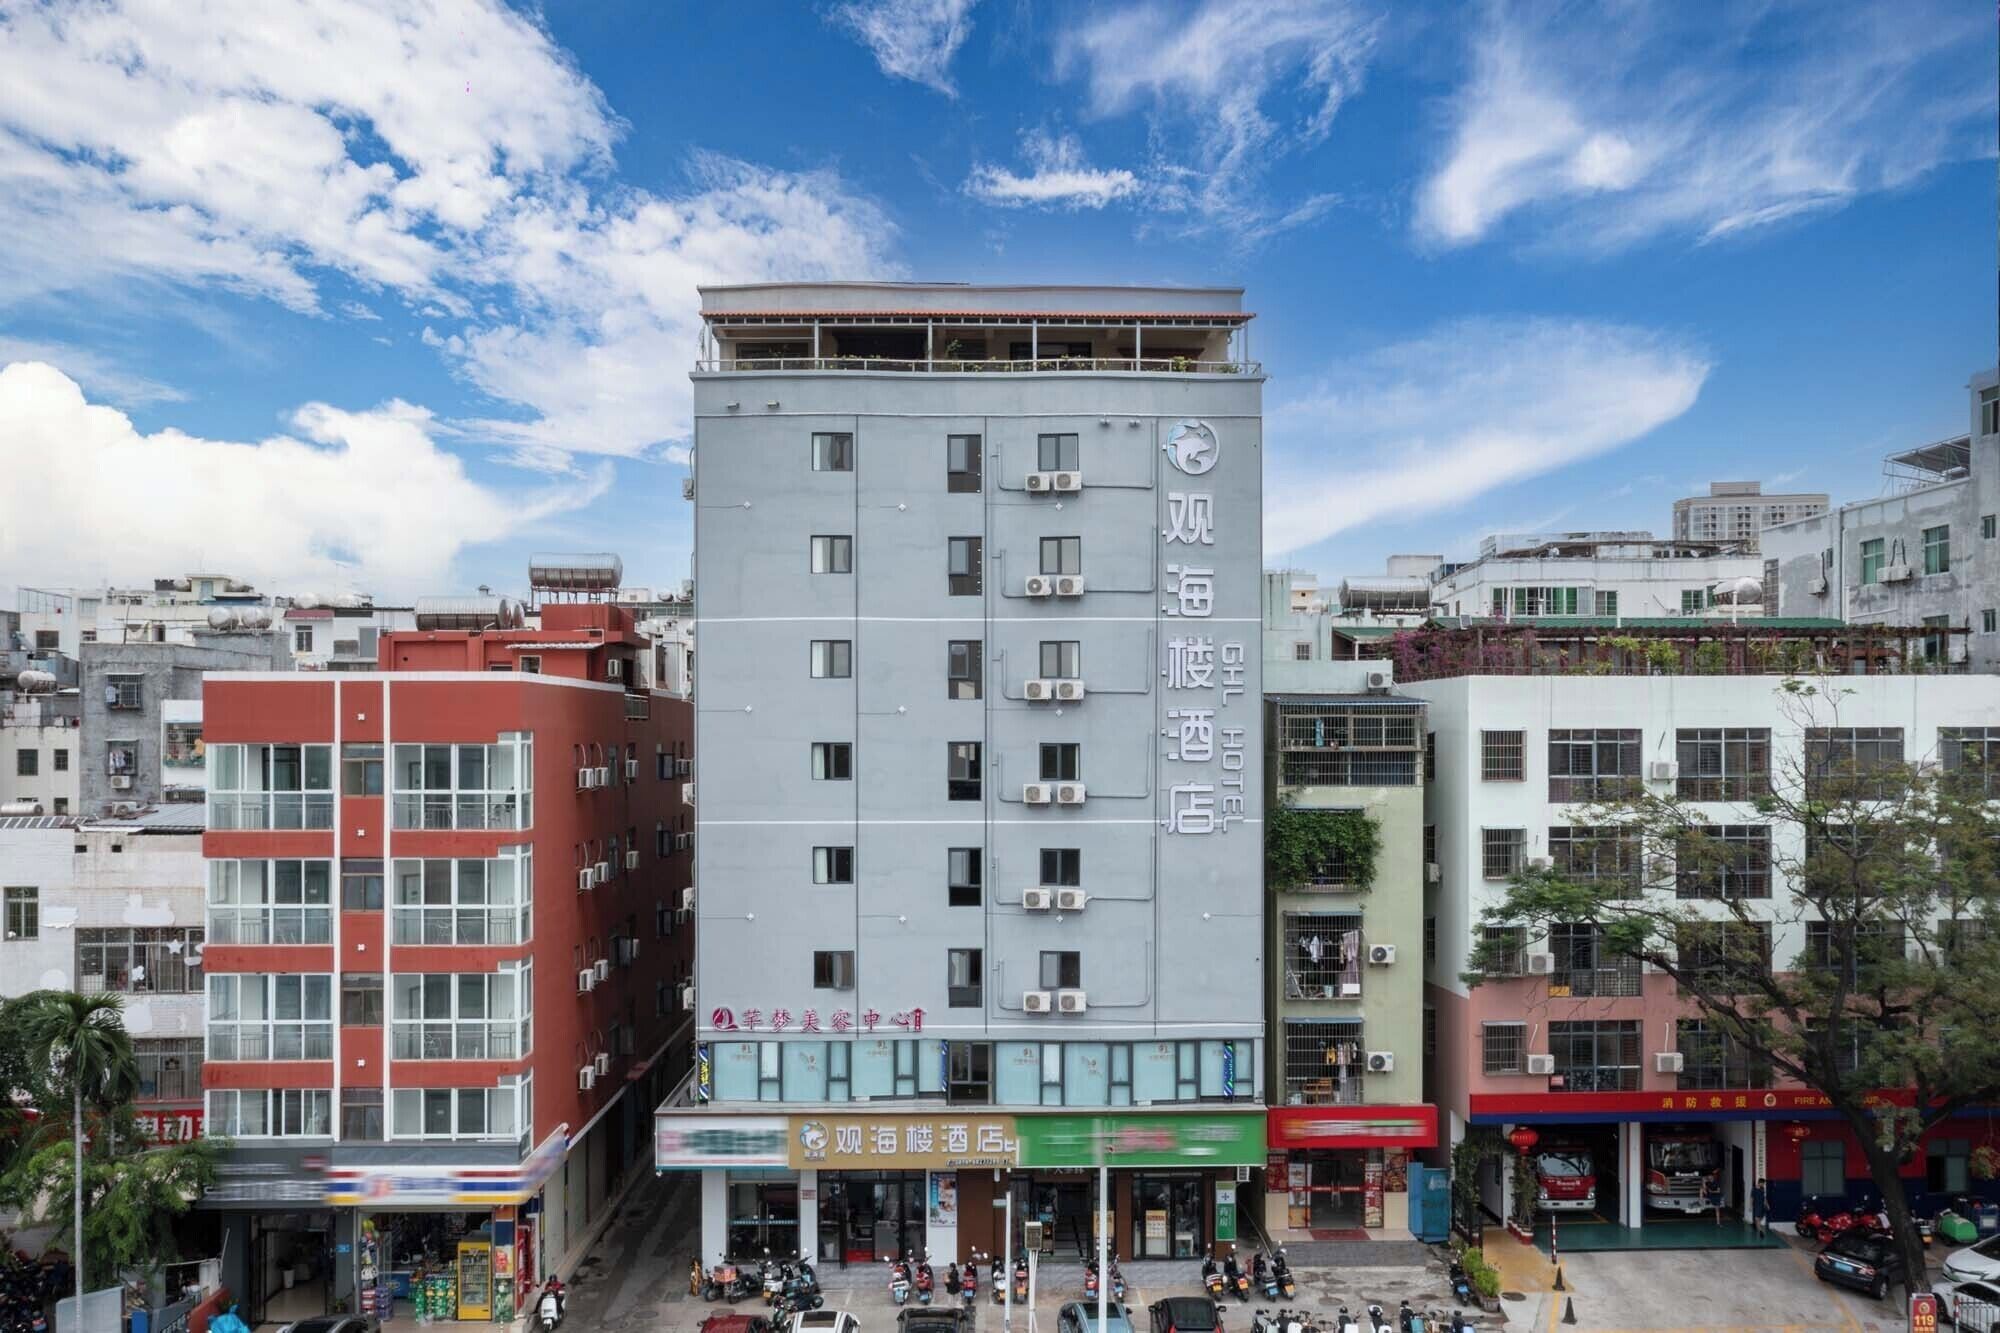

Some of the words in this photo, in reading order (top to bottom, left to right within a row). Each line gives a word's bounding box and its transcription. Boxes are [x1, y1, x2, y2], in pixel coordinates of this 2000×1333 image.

[1166, 490, 1215, 835] 观海楼酒店
[1221, 642, 1245, 707] GHL
[1221, 727, 1245, 834] HOTEL
[1662, 1096, 1747, 1109] 消防救援
[1794, 1096, 1815, 1106] FIRE
[835, 1123, 1004, 1154] 观海楼酒店
[1914, 1314, 1935, 1326] 119
